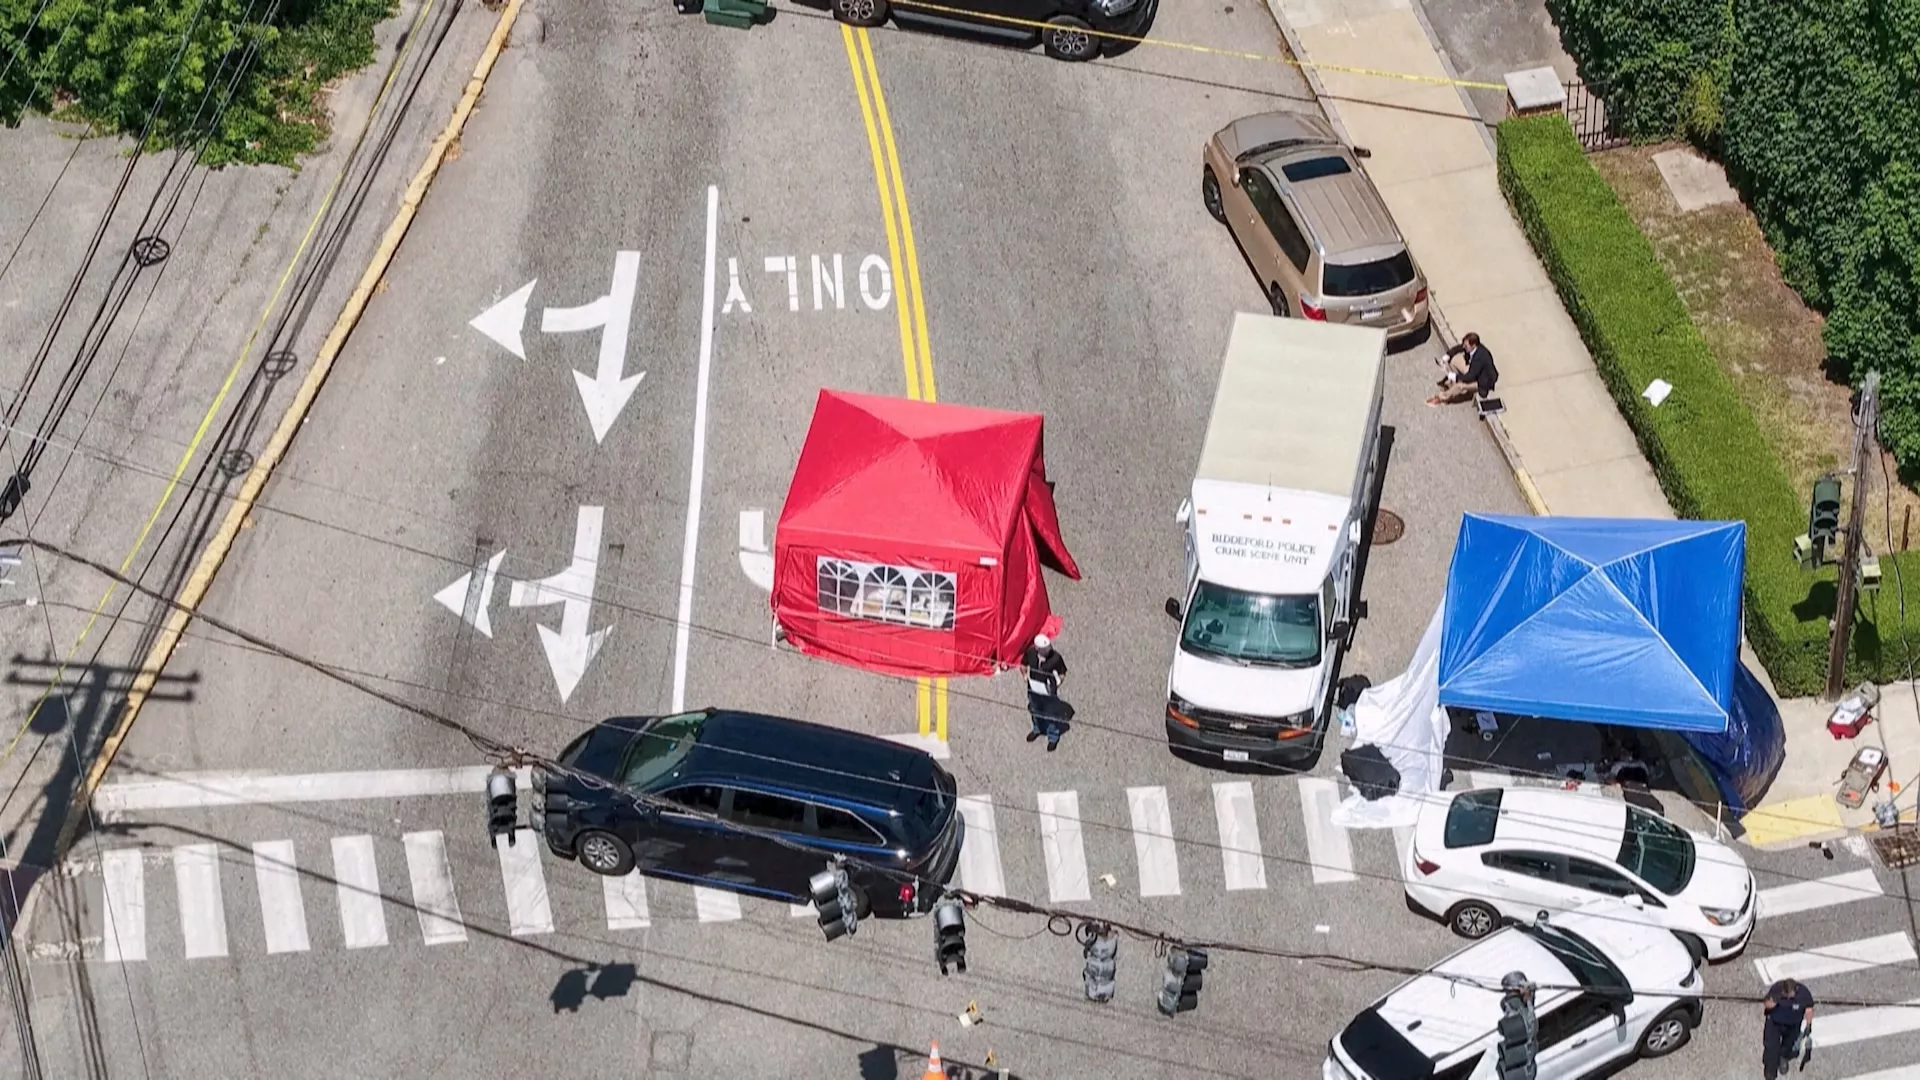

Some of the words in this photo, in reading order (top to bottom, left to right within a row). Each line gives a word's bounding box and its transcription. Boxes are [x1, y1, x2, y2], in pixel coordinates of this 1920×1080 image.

[721, 253, 892, 314] ONLY
[1212, 533, 1274, 548] BIDDEFORD
[1277, 542, 1316, 555] POLICE
[1215, 546, 1247, 558] CRIME
[1249, 551, 1280, 561] SCENE
[1283, 554, 1309, 566] UNIT
